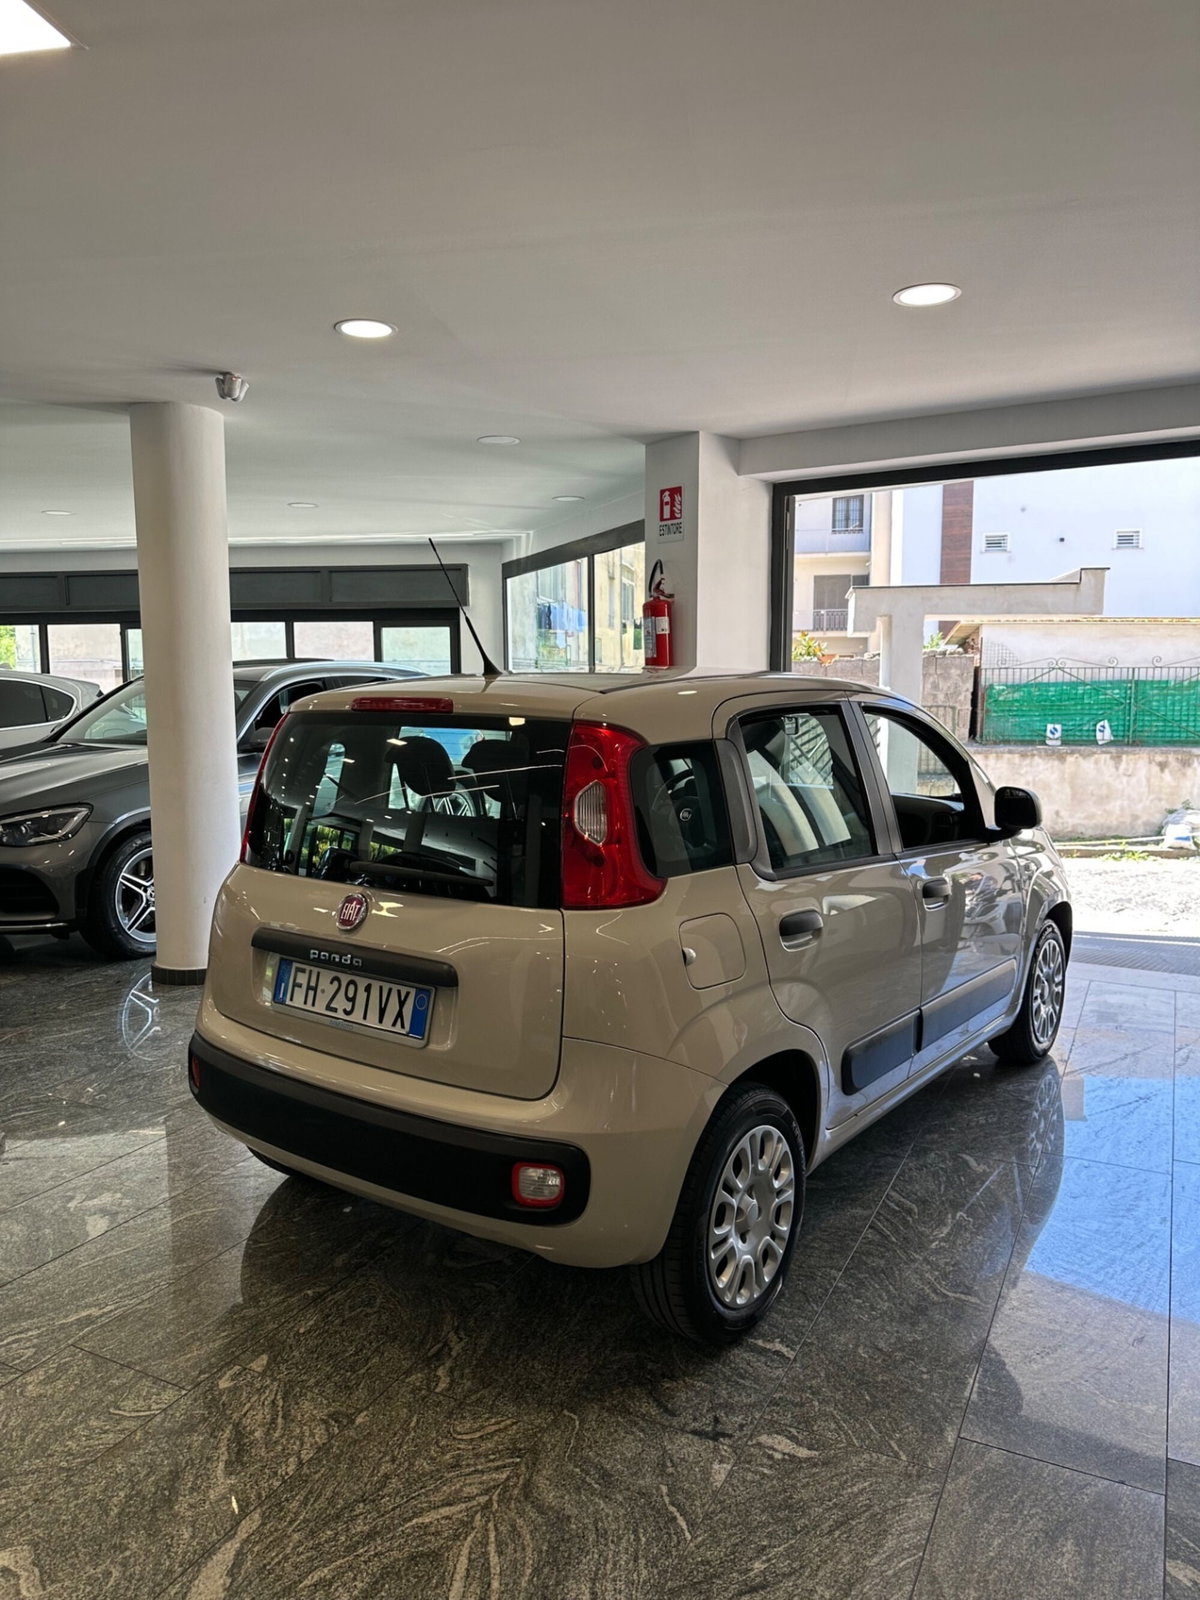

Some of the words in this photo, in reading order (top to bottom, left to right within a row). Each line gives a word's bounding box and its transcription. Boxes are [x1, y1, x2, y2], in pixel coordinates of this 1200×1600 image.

[658, 521, 682, 537] ESTINTORE
[340, 900, 361, 921] FIAT
[309, 949, 363, 967] panda
